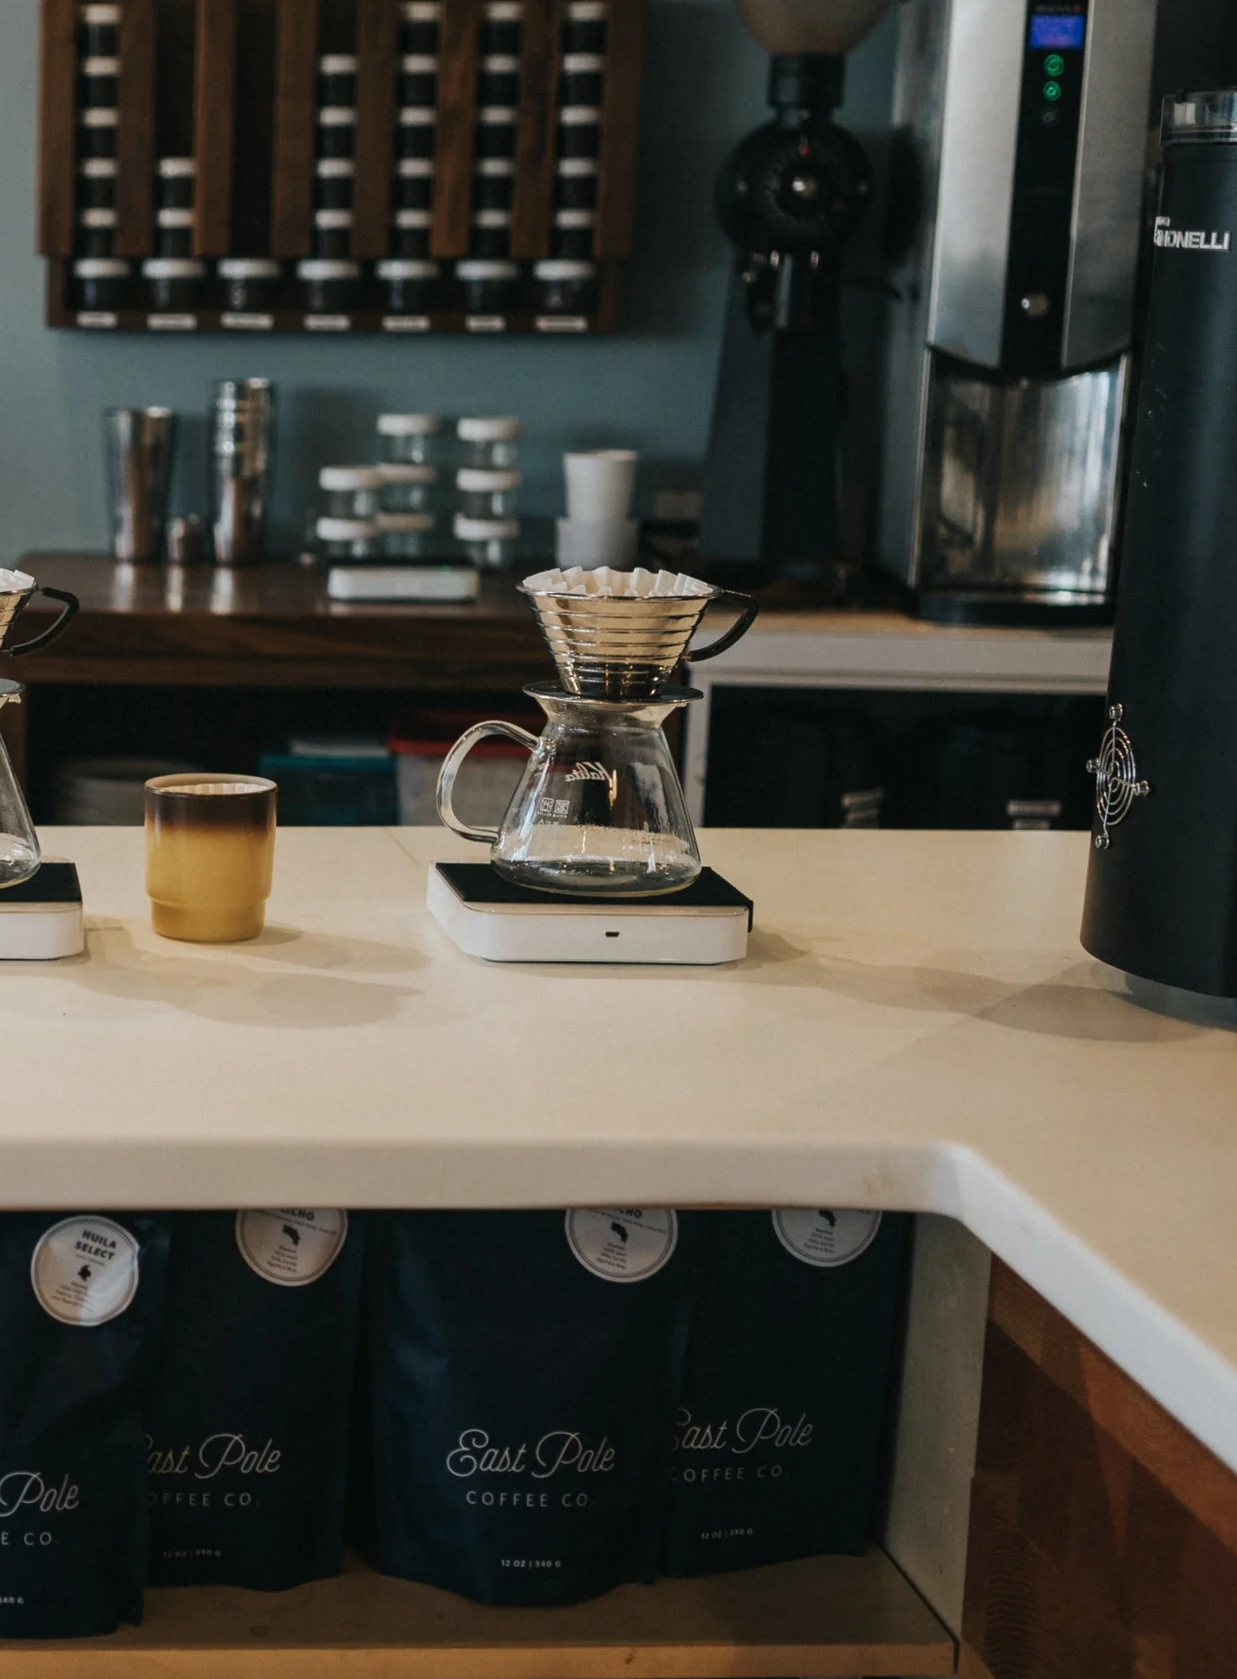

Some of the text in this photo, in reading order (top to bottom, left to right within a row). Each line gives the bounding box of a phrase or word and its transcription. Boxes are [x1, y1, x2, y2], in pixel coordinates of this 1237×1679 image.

[82, 1229, 117, 1249] HUILA
[74, 1240, 116, 1260] SELECT
[731, 1407, 813, 1454] Pole
[144, 1433, 281, 1479] ast Pole
[446, 1428, 616, 1478] East Pole
[756, 1464, 789, 1479] CO.
[147, 1492, 260, 1507] OFFEE CO.
[466, 1490, 549, 1508] COFFEE
[501, 1559, 511, 1567] 12
[513, 1559, 527, 1568] OZ
[534, 1560, 553, 1568] 340
